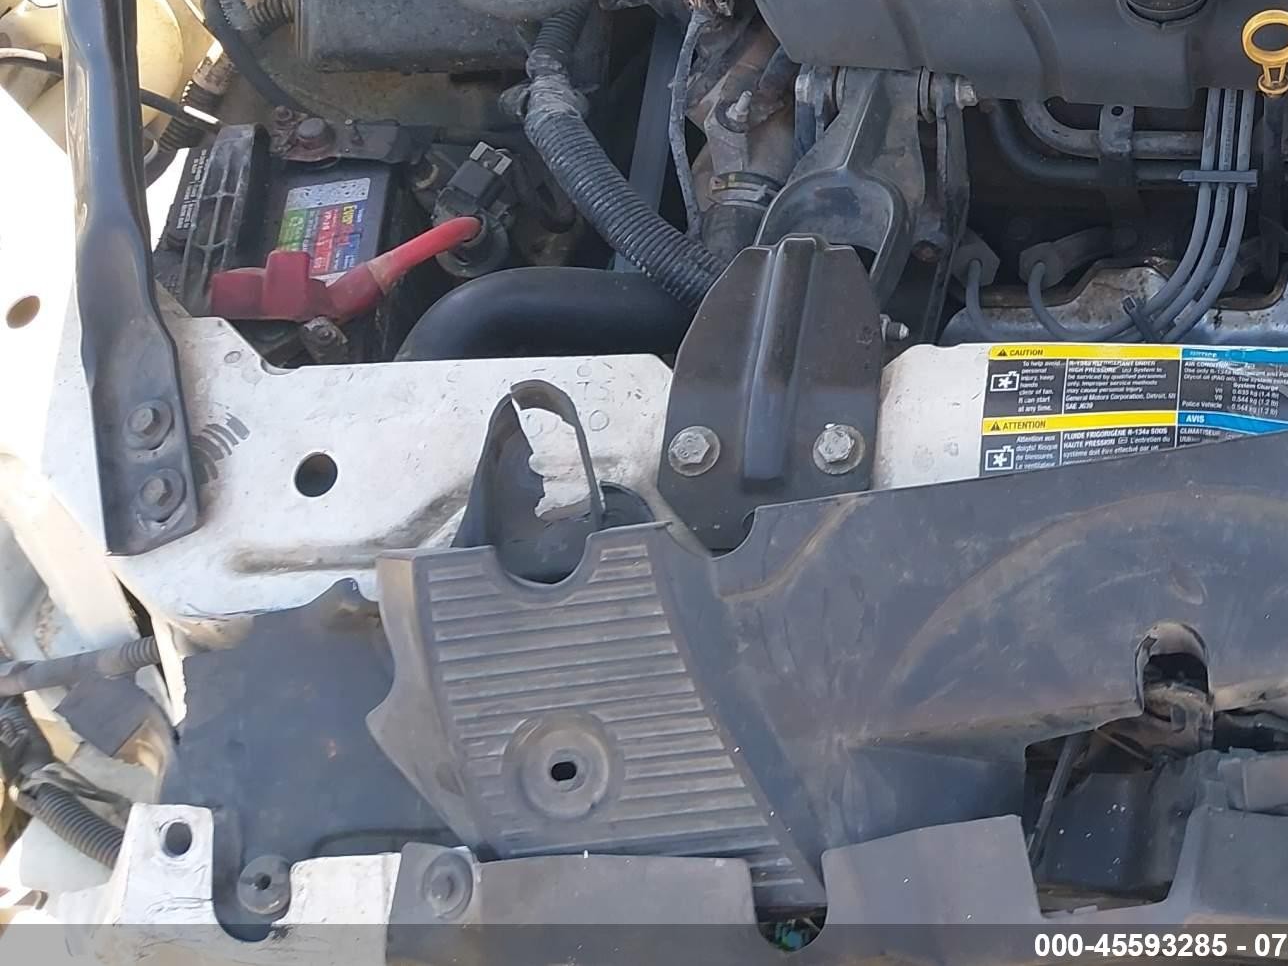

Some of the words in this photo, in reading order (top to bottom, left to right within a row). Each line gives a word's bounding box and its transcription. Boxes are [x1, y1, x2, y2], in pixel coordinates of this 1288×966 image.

[1186, 415, 1205, 423] AVIS
[1002, 421, 1046, 430] ATTENTION
[1064, 432, 1085, 440] FLUIDE
[1063, 440, 1083, 449] HAUTE
